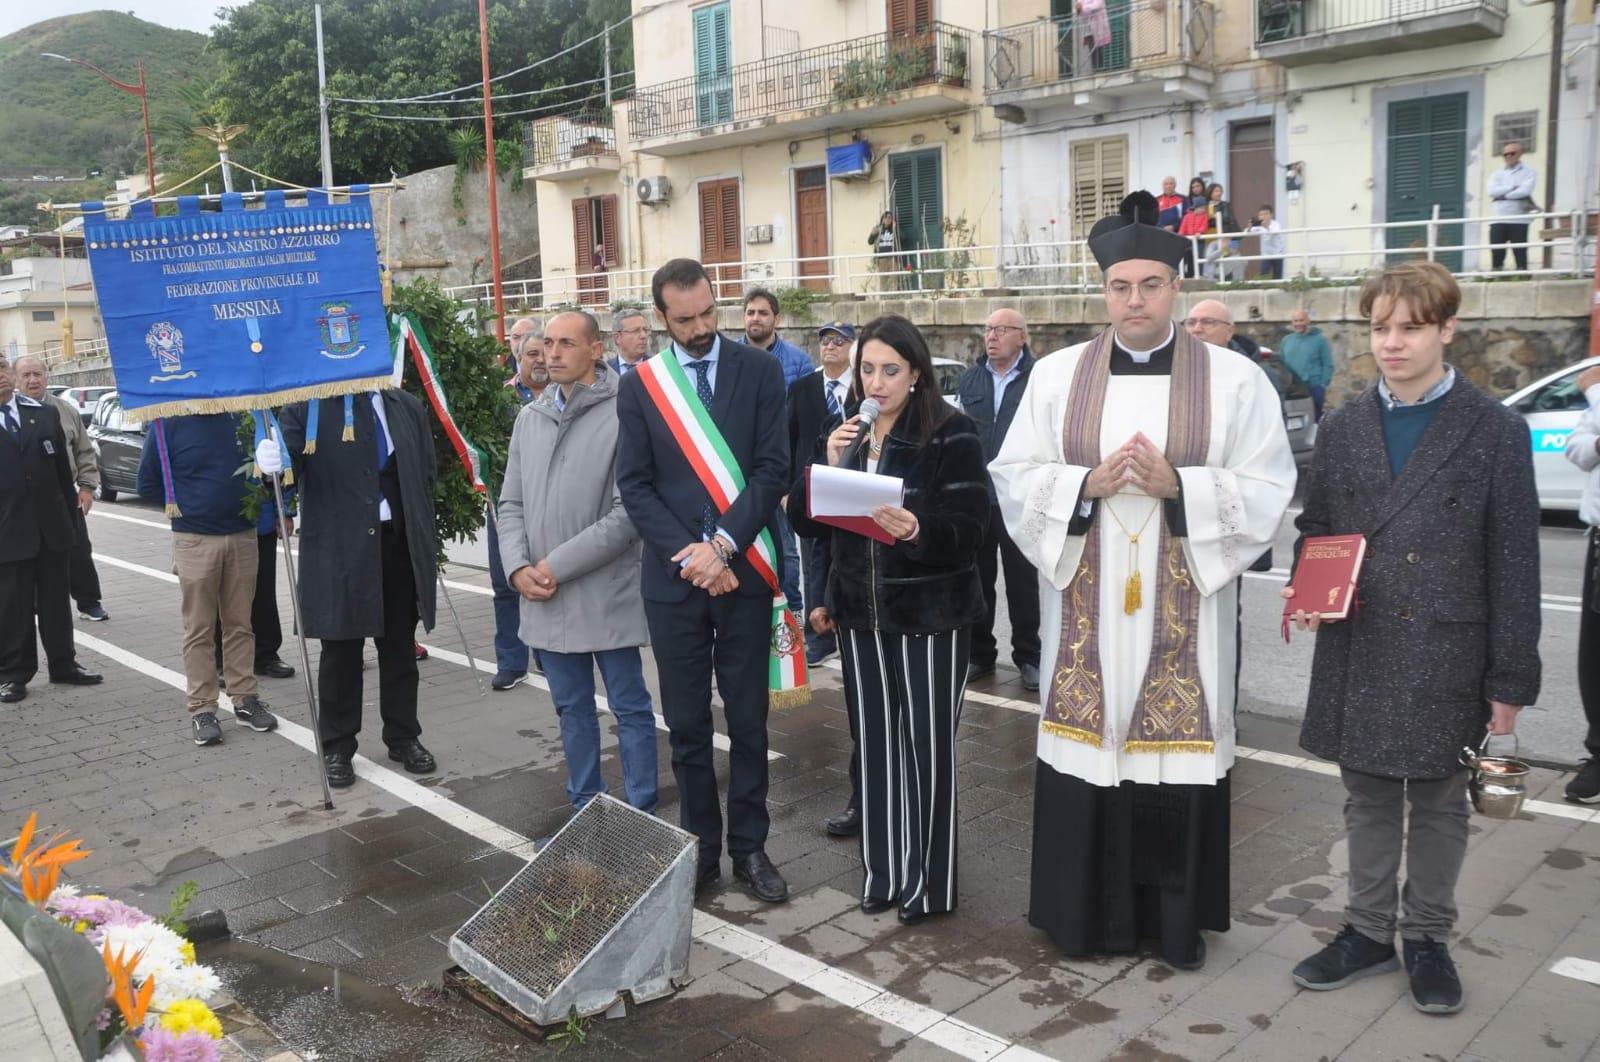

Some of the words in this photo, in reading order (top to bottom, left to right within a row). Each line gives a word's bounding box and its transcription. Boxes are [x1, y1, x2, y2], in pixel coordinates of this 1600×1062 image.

[130, 244, 195, 262] ISTITUTO
[198, 242, 225, 256] DEL
[226, 238, 278, 254] NASTRO
[280, 233, 341, 249] AZZURRO
[162, 264, 176, 275] FRA
[176, 259, 224, 273] COMBATTENTI
[166, 279, 240, 299] FEDERAZIONE
[241, 273, 305, 292] PROVINCIALE
[307, 271, 320, 285] DI
[212, 299, 281, 320] MESSINA
